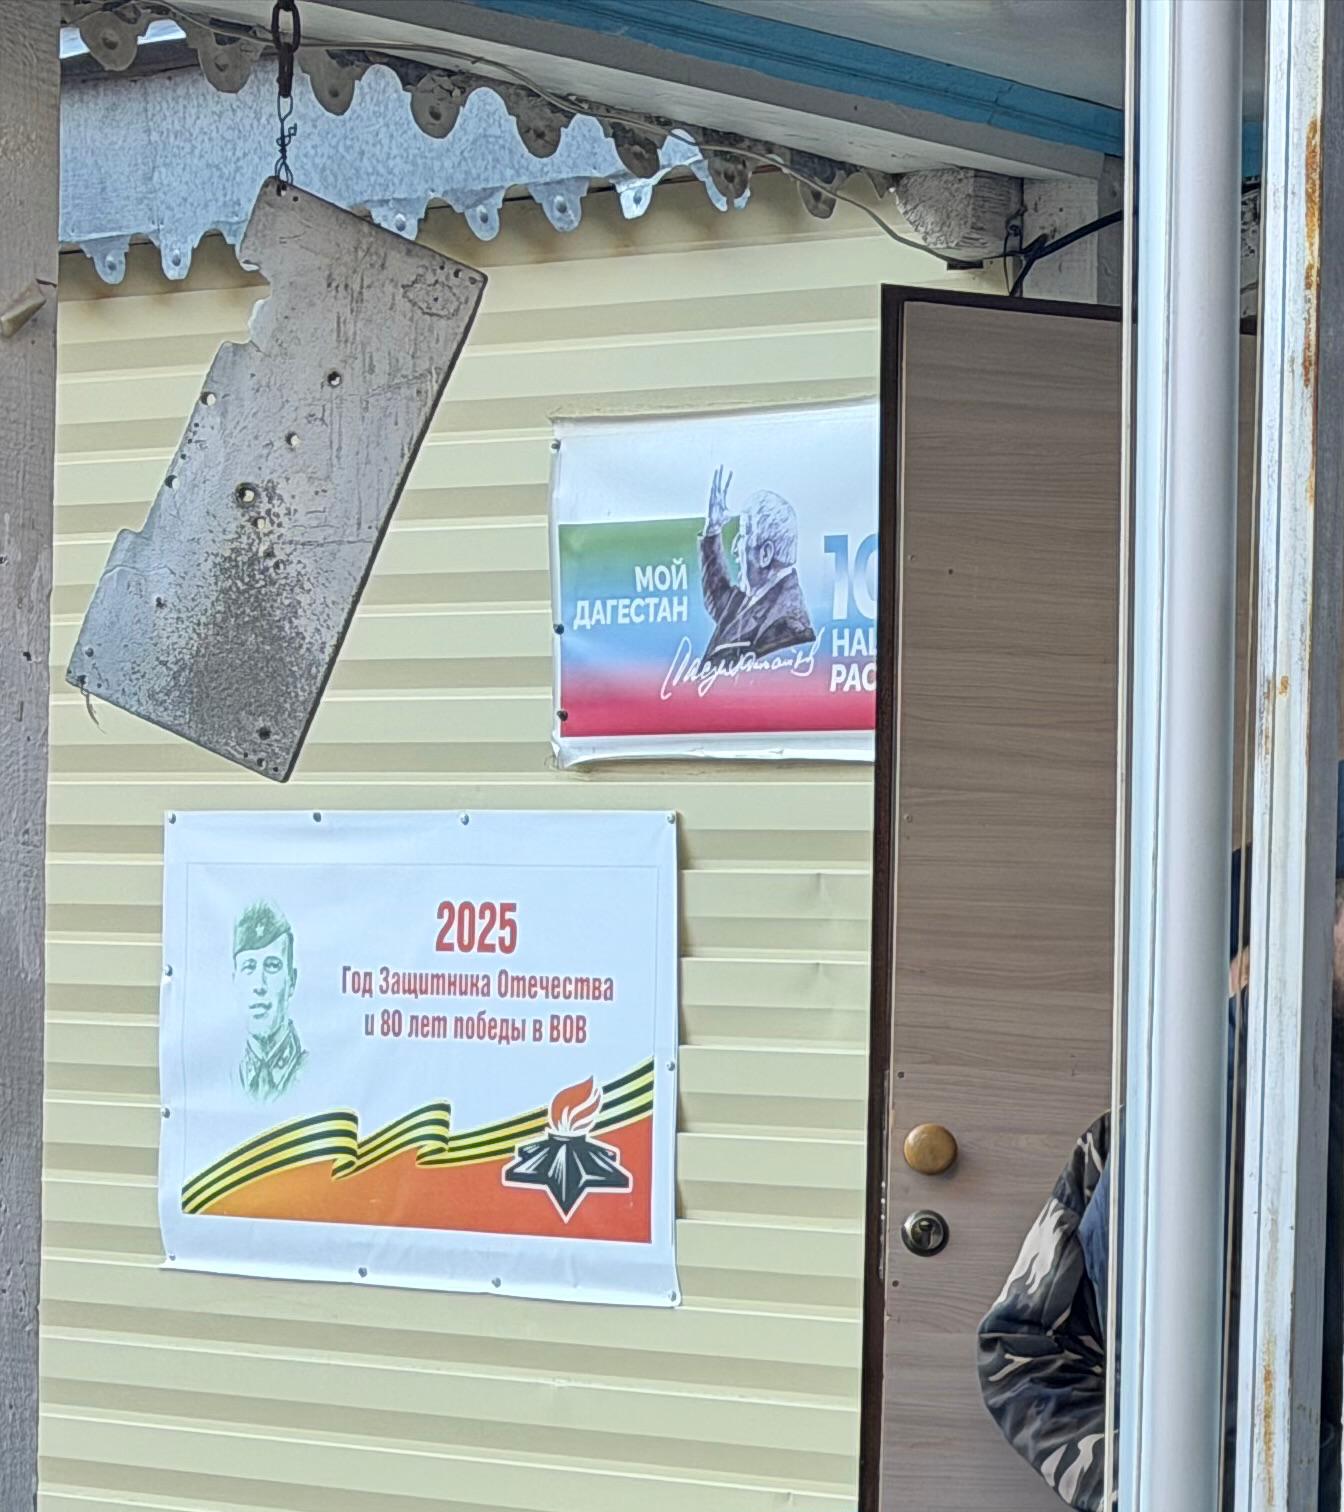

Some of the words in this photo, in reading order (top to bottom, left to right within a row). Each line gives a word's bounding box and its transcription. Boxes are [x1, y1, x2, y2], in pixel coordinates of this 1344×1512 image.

[635, 557, 688, 592] МОЙ
[572, 597, 688, 629] ДАГЕСТАН
[435, 900, 518, 954] 2025
[341, 965, 373, 999] Год
[378, 966, 491, 999] Защитника
[497, 969, 615, 1002] Отечества
[364, 1013, 375, 1037] и
[380, 1008, 402, 1038] 80
[407, 1013, 448, 1039] лет
[453, 1010, 526, 1045] победы
[532, 1018, 543, 1042] в
[549, 1014, 588, 1044] ВОВ
